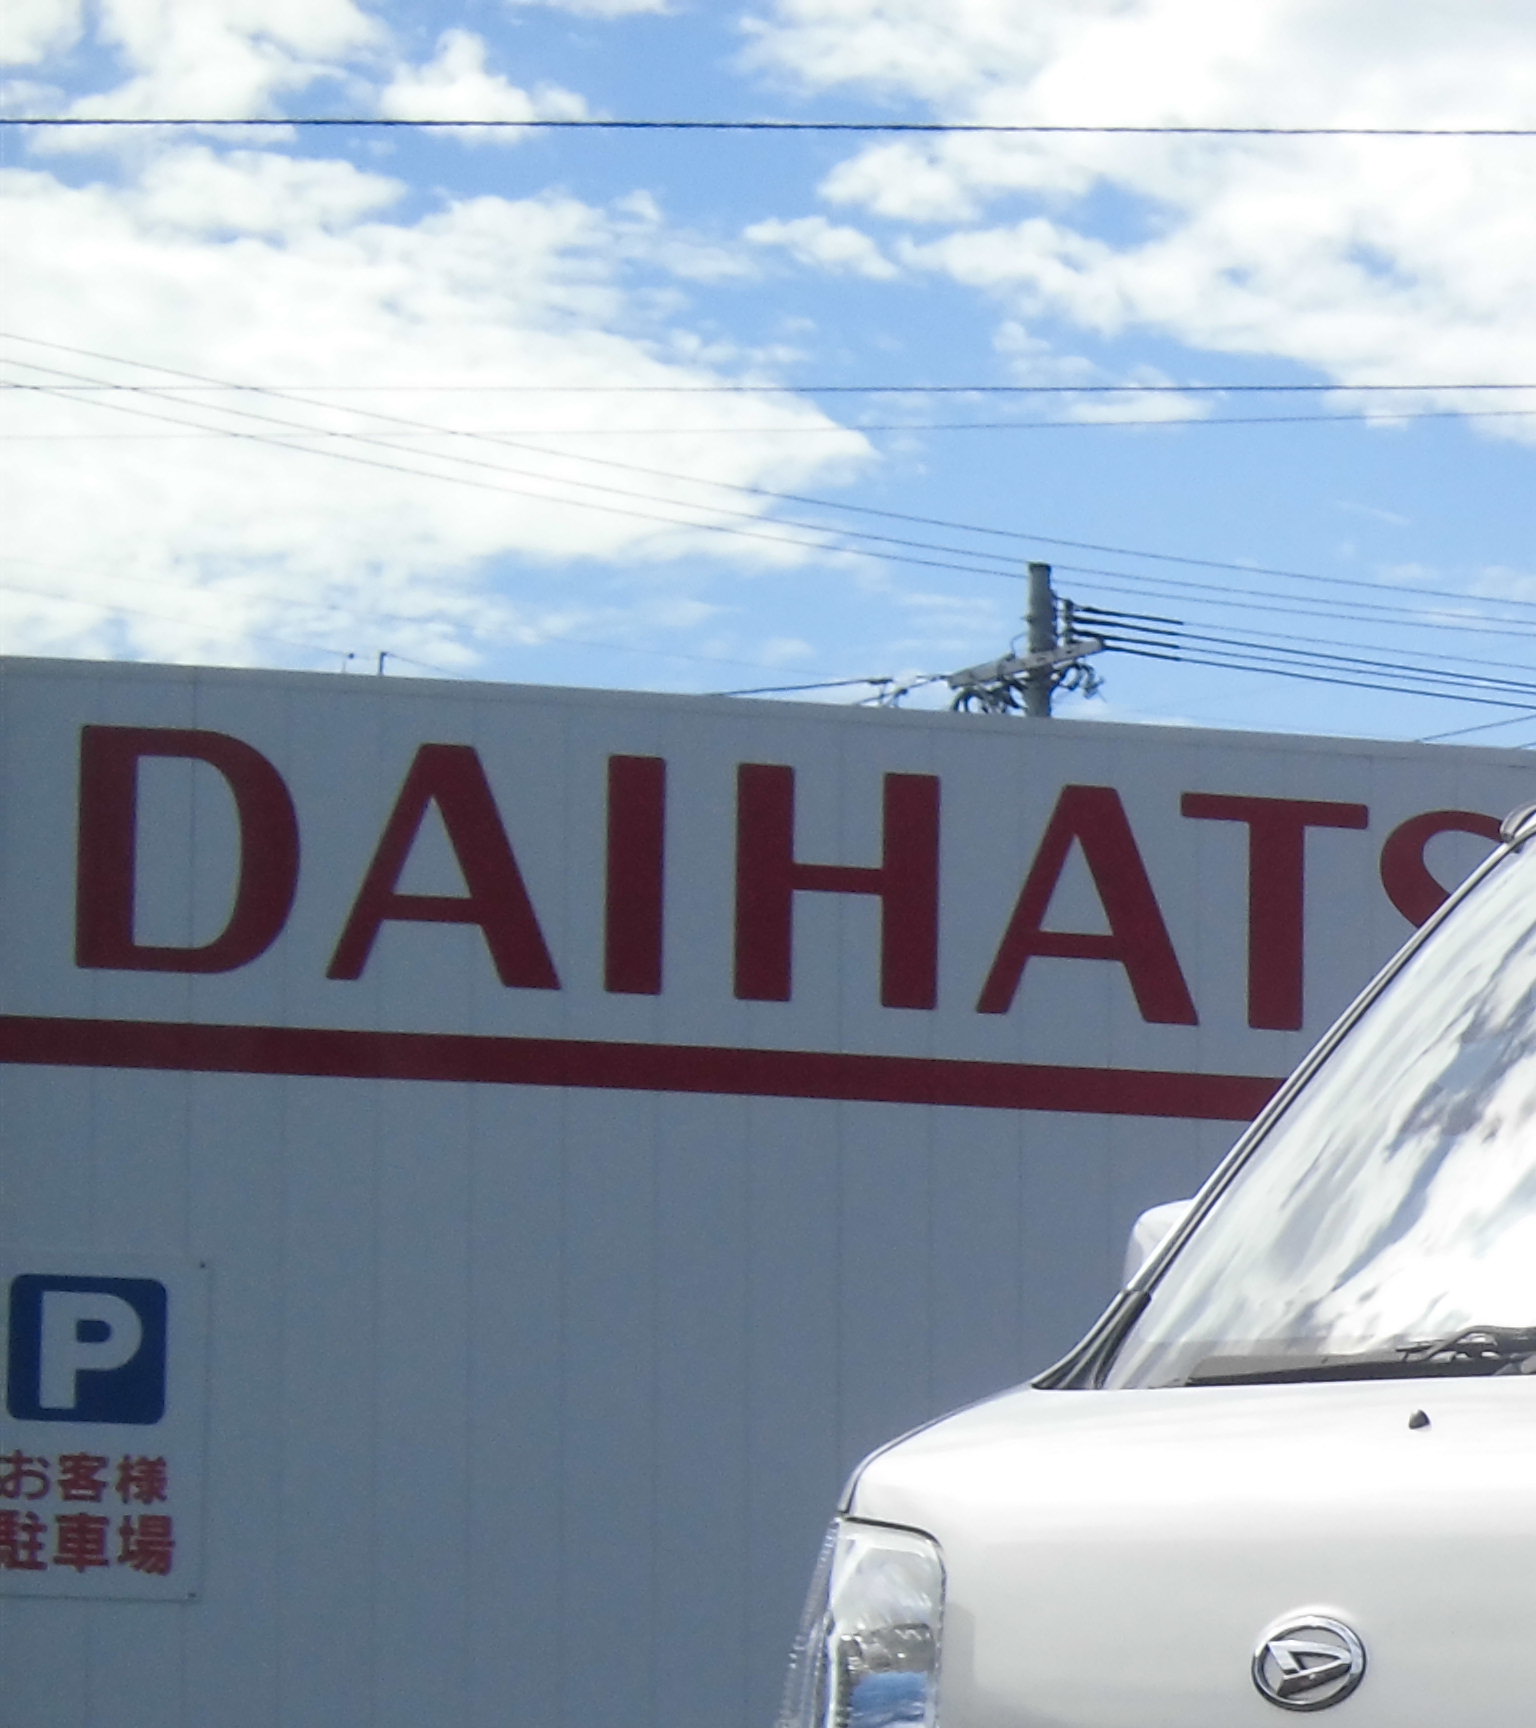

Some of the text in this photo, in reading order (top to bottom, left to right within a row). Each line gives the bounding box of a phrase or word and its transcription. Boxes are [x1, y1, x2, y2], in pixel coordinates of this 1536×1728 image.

[39, 1289, 143, 1410] P
[0, 1450, 168, 1505] お客様
[0, 1509, 176, 1577] 駐車場
